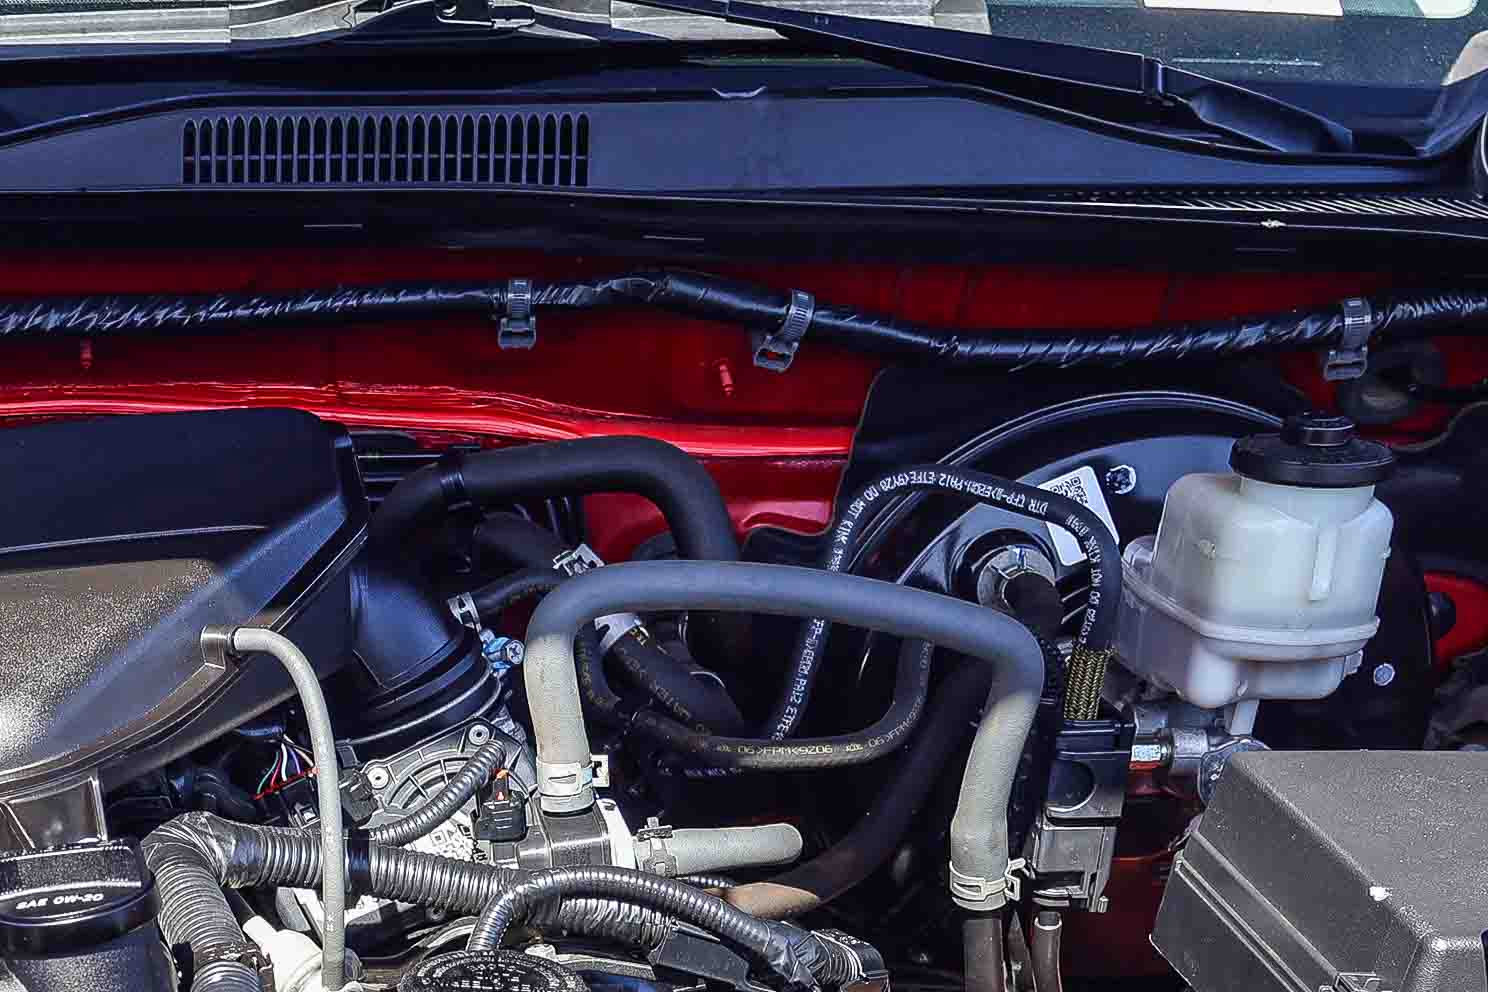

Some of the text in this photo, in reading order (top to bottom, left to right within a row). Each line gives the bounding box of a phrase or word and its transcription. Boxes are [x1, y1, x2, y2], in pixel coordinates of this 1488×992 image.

[863, 485, 880, 501] DO
[1090, 568, 1104, 588] NOT
[1089, 590, 1101, 606] DO
[16, 893, 104, 910] SAE 0W-20
